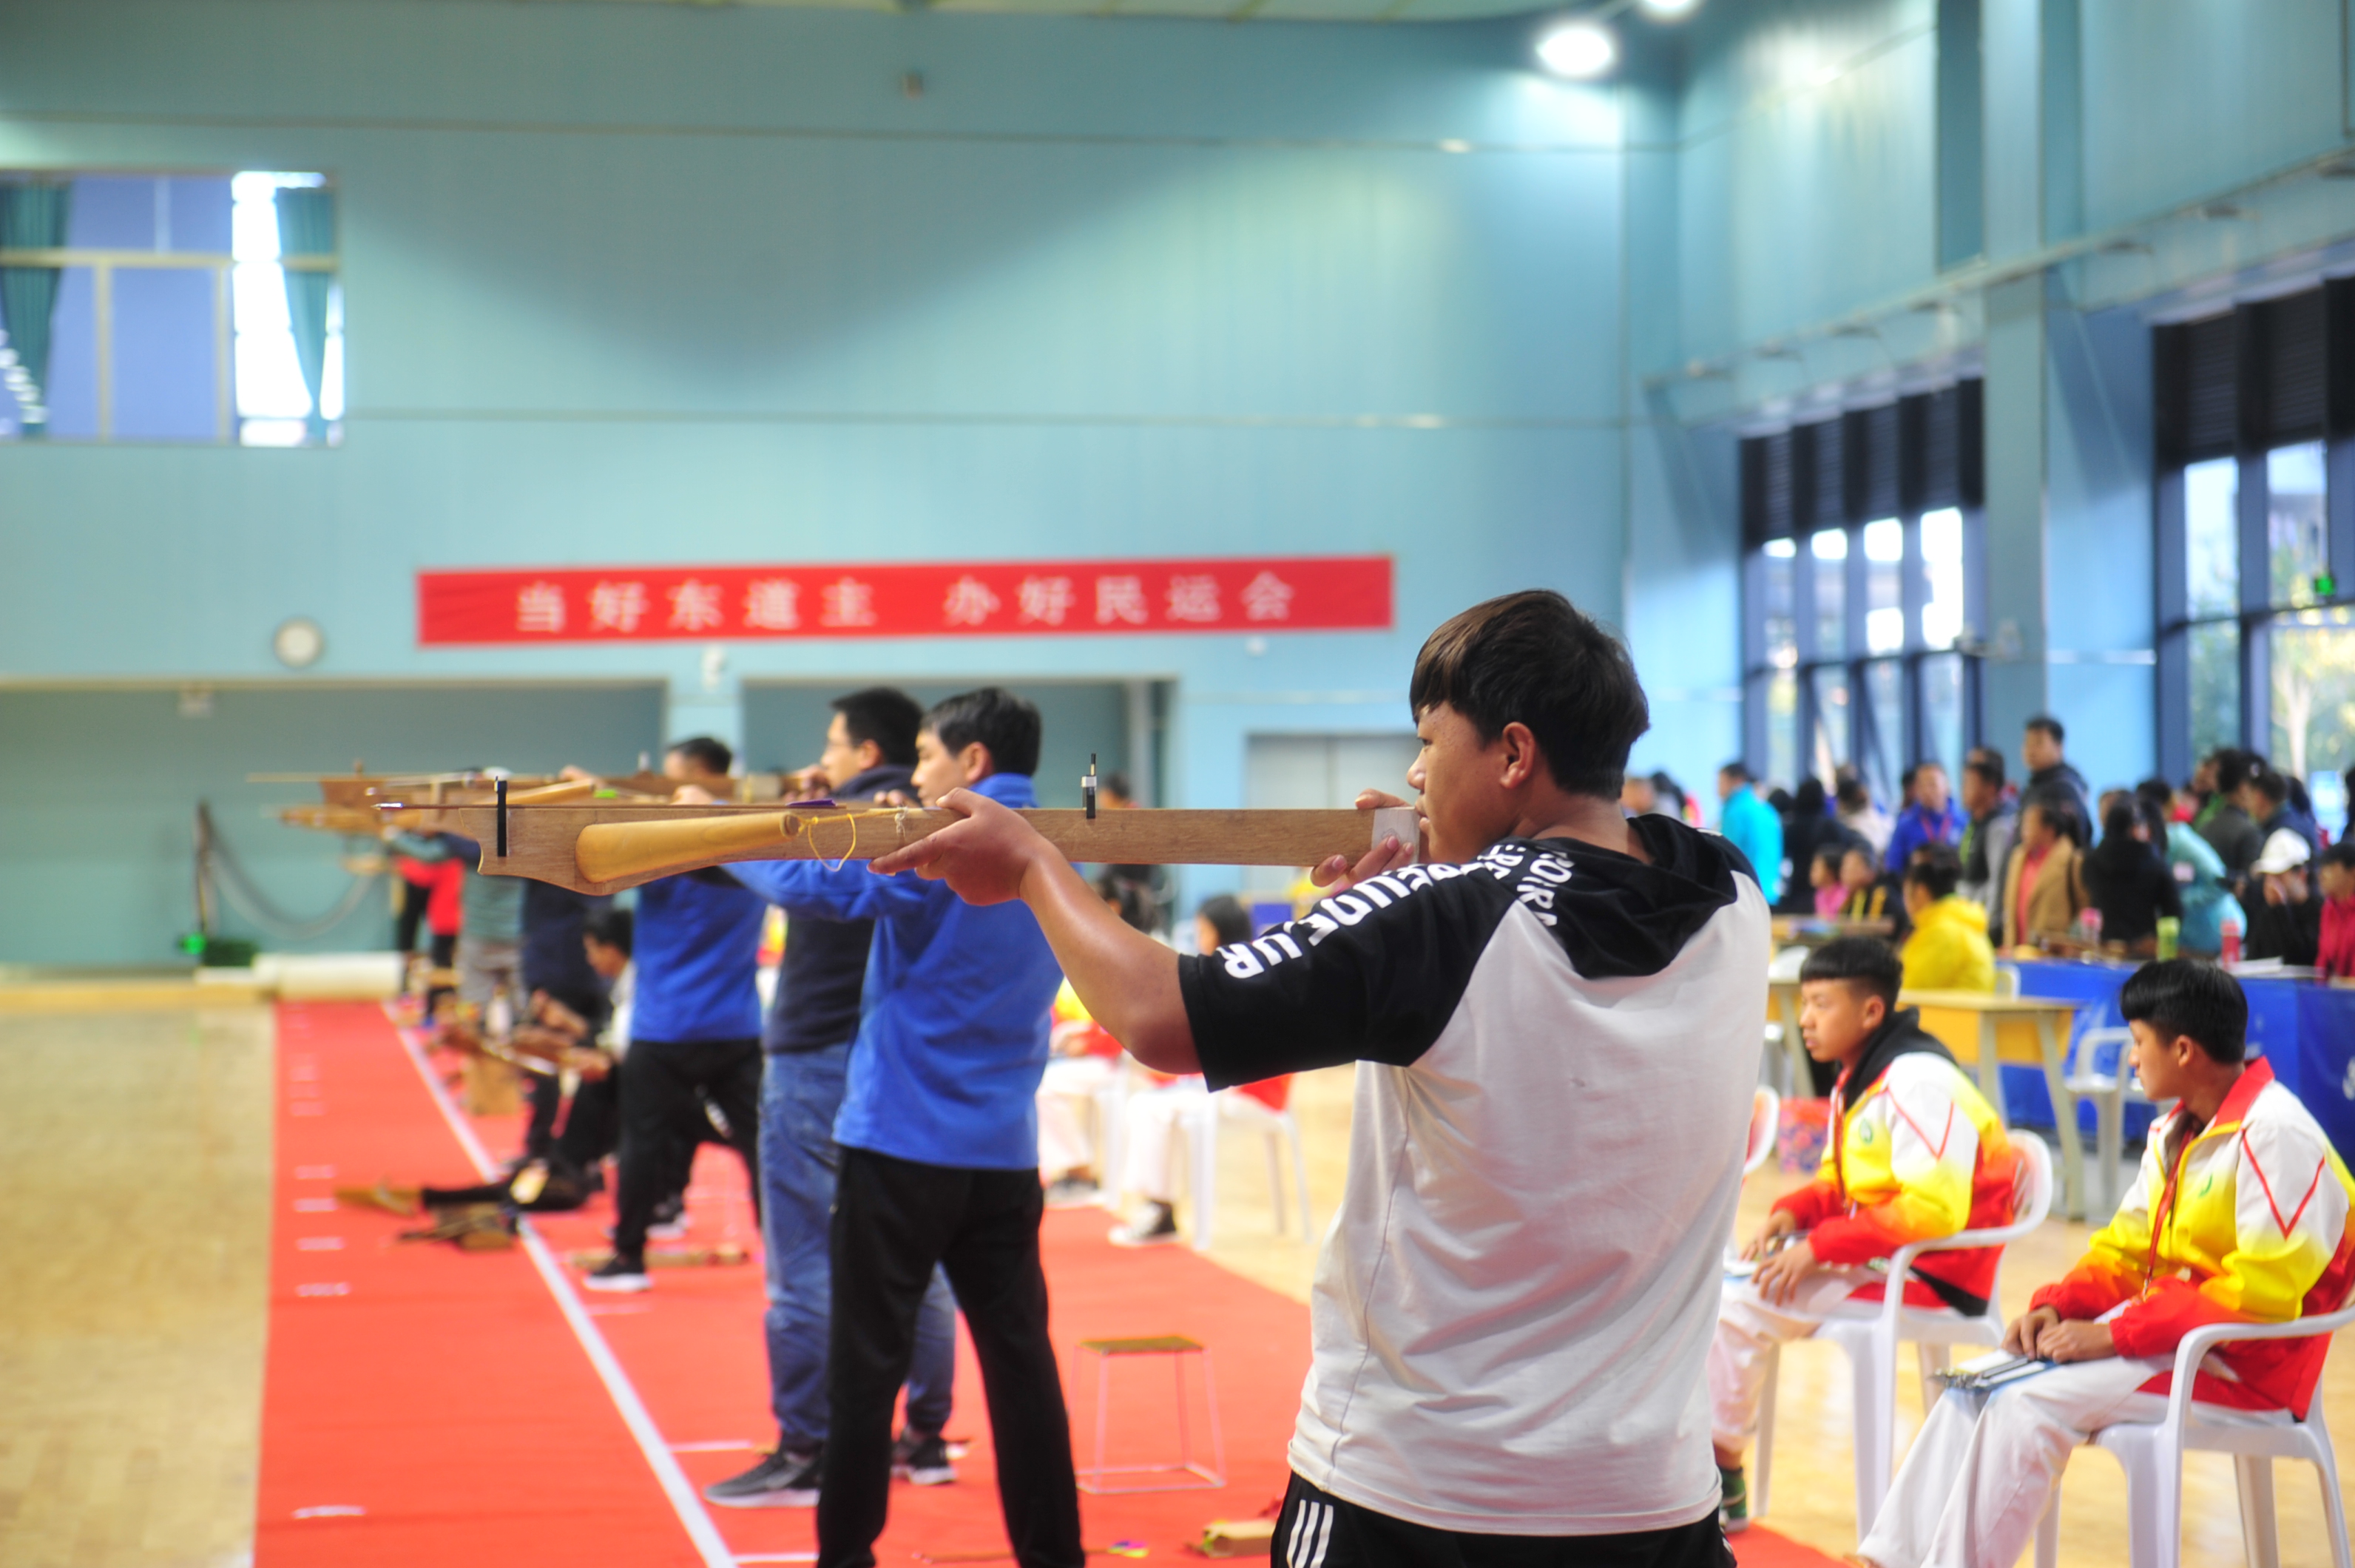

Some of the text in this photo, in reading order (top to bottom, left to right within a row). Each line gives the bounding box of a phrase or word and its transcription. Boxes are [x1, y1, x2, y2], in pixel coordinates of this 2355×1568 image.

[516, 570, 1295, 634] 当好东道主 办好民运会
